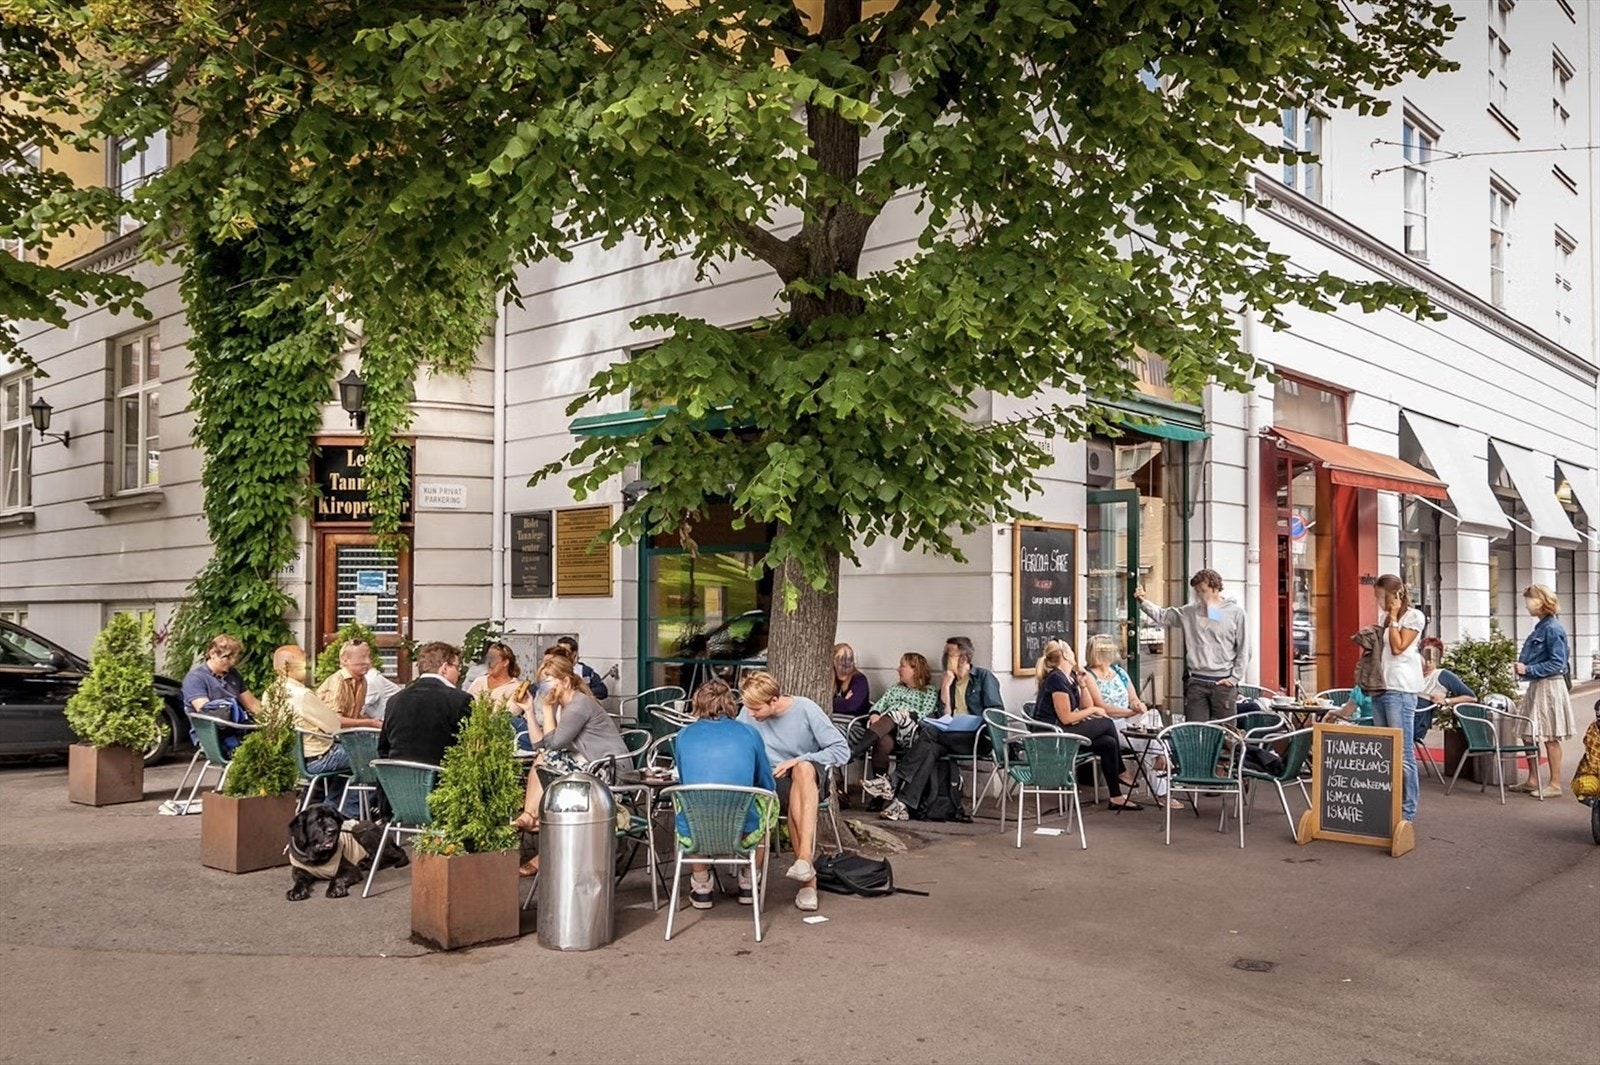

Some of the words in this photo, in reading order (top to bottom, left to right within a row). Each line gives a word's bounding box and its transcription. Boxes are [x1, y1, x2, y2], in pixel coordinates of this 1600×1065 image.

[347, 449, 374, 468] Leg
[423, 487, 437, 495] KUN
[439, 487, 462, 496] PRIVAT
[318, 496, 410, 519] Kiroprar
[425, 496, 461, 505] PARKERING
